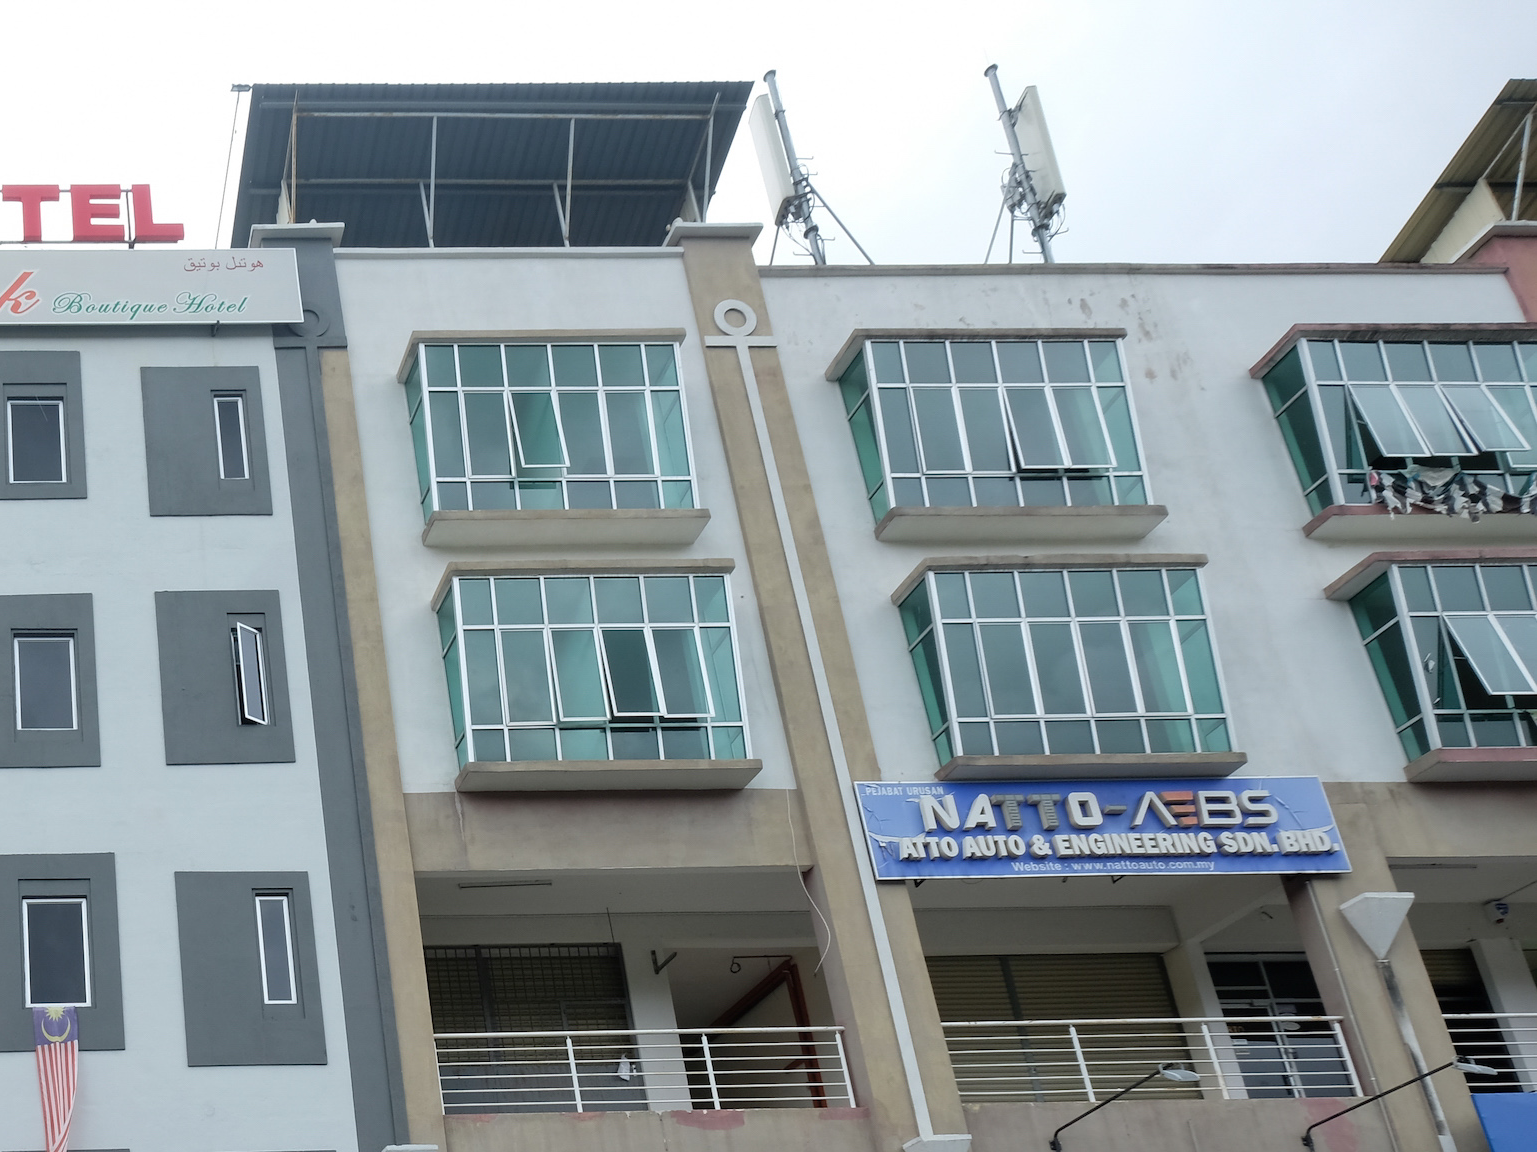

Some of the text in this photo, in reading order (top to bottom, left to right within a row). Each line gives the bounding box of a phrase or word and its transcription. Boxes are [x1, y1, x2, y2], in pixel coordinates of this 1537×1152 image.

[52, 291, 248, 320] Boutique Hotel
[865, 786, 944, 797] PEJABAT URUSAN
[963, 834, 1026, 860] AUTO
[1029, 834, 1052, 859] &
[1052, 832, 1217, 858] ENGINEERING
[1215, 830, 1280, 855] SDN.
[1277, 831, 1339, 856] BHD.
[1012, 862, 1062, 871] Website
[1071, 860, 1215, 872] www.nattoauto.com.my
